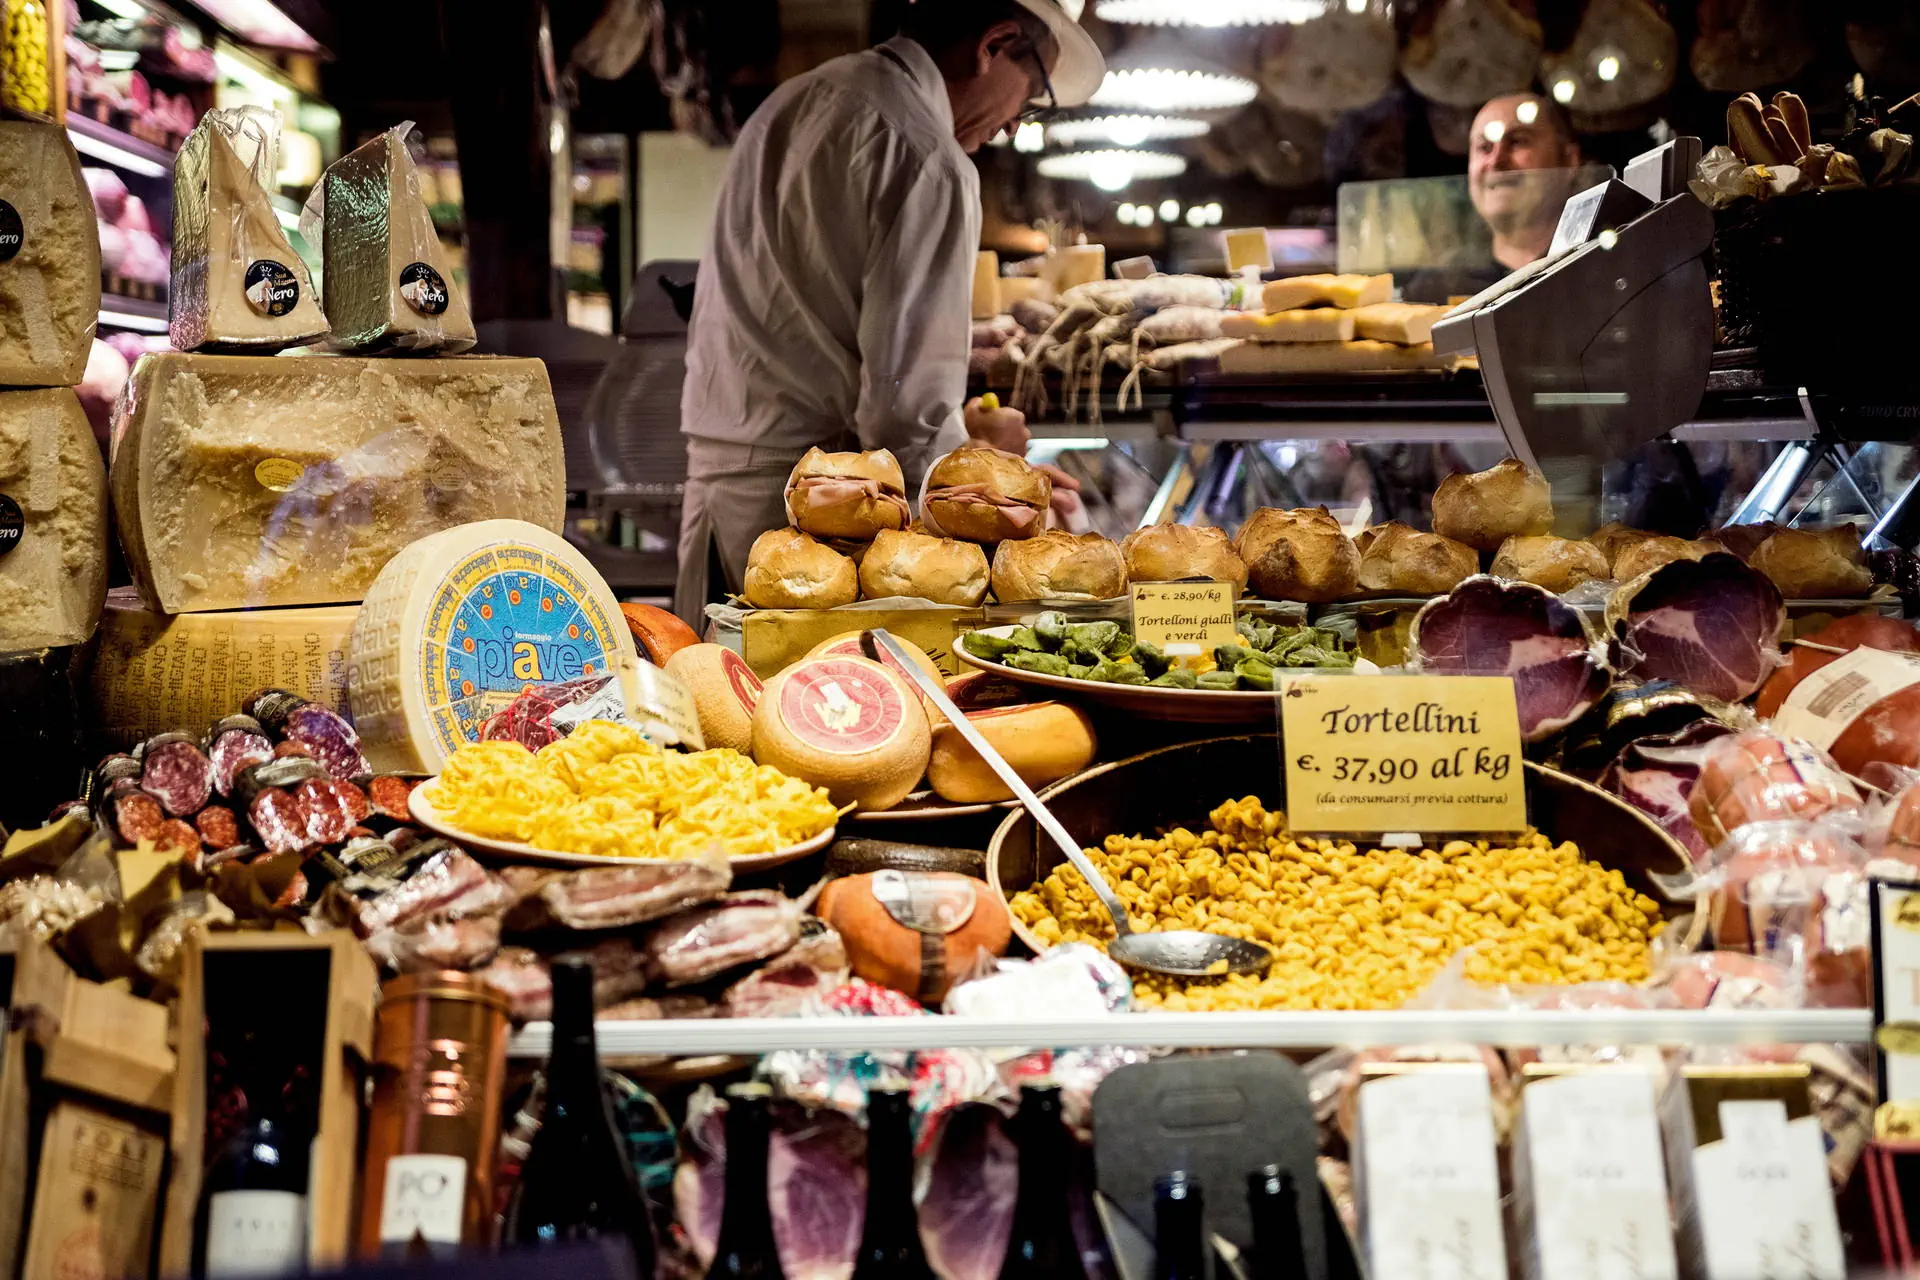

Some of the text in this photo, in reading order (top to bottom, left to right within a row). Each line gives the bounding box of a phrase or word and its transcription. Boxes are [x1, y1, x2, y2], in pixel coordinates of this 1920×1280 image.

[0, 234, 19, 244] ero
[265, 287, 295, 301] Nero
[418, 287, 444, 303] Nero
[0, 528, 18, 539] ero
[1173, 588, 1221, 602] 28,90/kg
[1139, 613, 1233, 628] Tortelloni gialli
[514, 630, 552, 642] formaggio
[1165, 629, 1208, 641] e verdi
[477, 626, 583, 690] piave
[1321, 702, 1481, 735] Tortellini
[1297, 746, 1511, 784] €. 37,90 al kg
[1316, 791, 1509, 807] (da consumarsi previa cottura)
